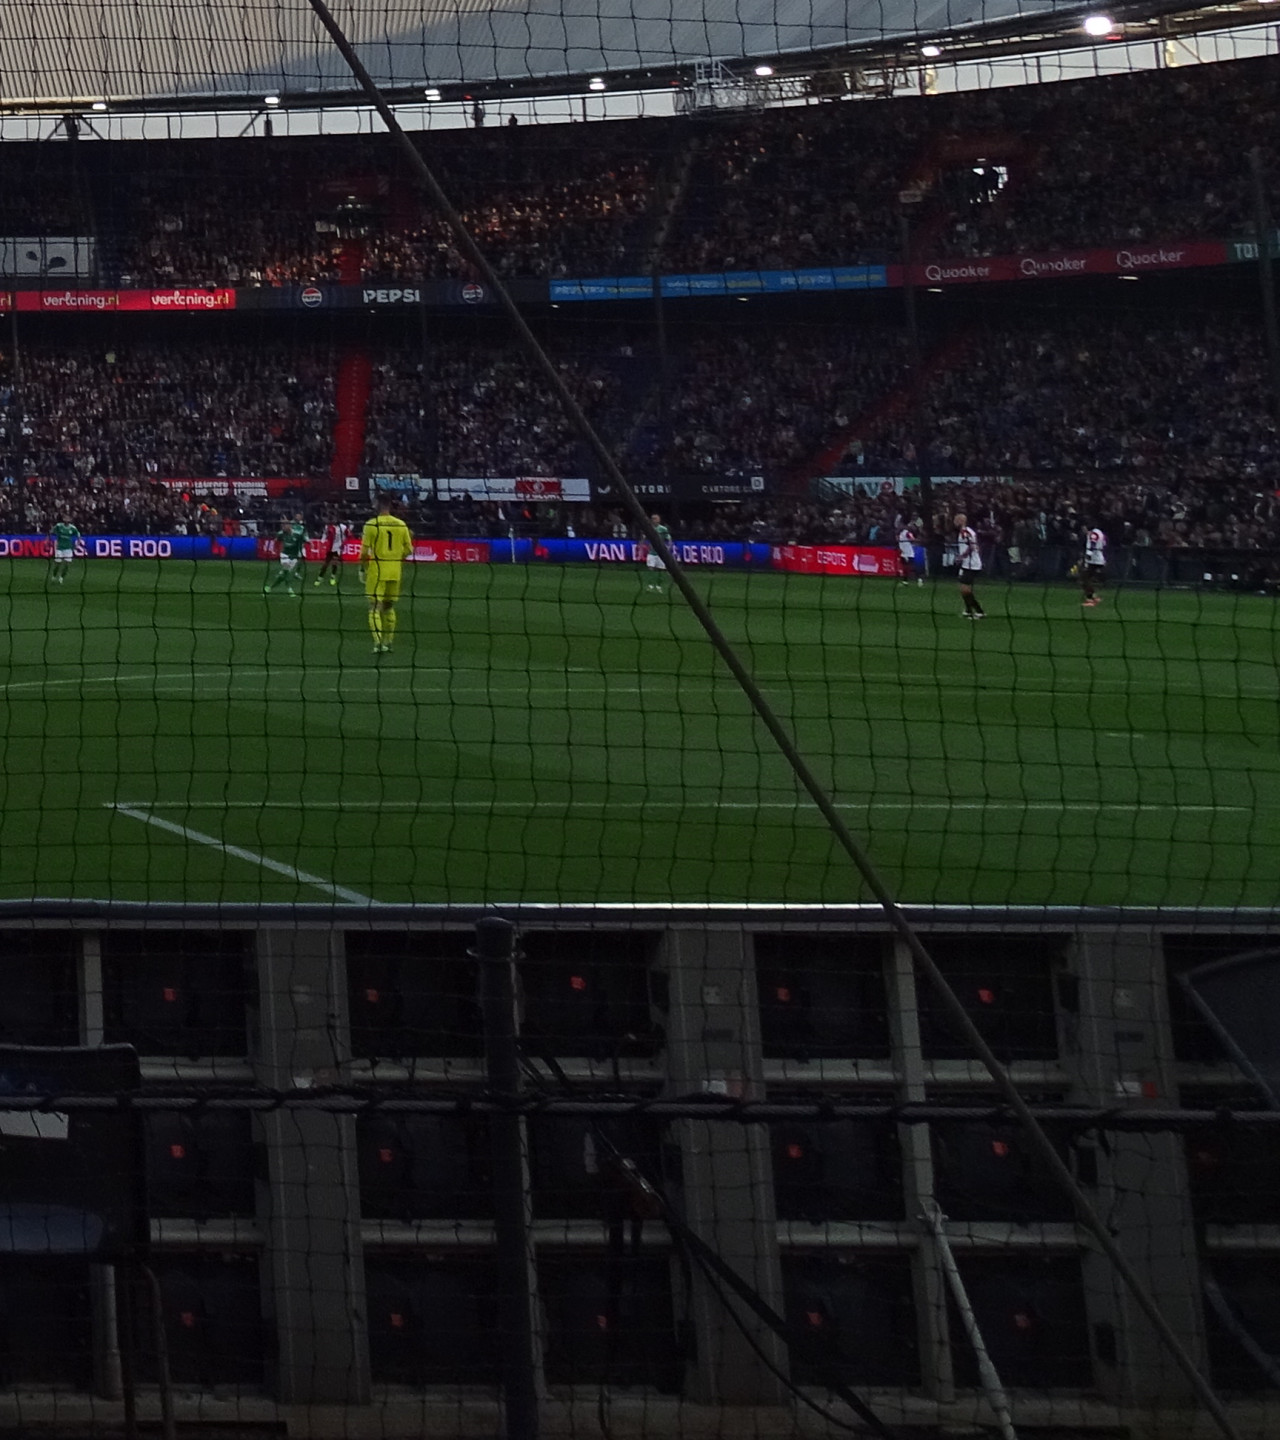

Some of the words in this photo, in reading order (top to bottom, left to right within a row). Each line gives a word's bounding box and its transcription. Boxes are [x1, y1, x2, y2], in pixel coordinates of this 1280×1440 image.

[151, 290, 229, 307] verloning.nl
[363, 289, 421, 303] PEPSI
[96, 539, 122, 557] DE
[130, 539, 172, 557] ROO
[385, 529, 393, 550] 1
[584, 542, 626, 561] VAN
[683, 545, 700, 564] DE
